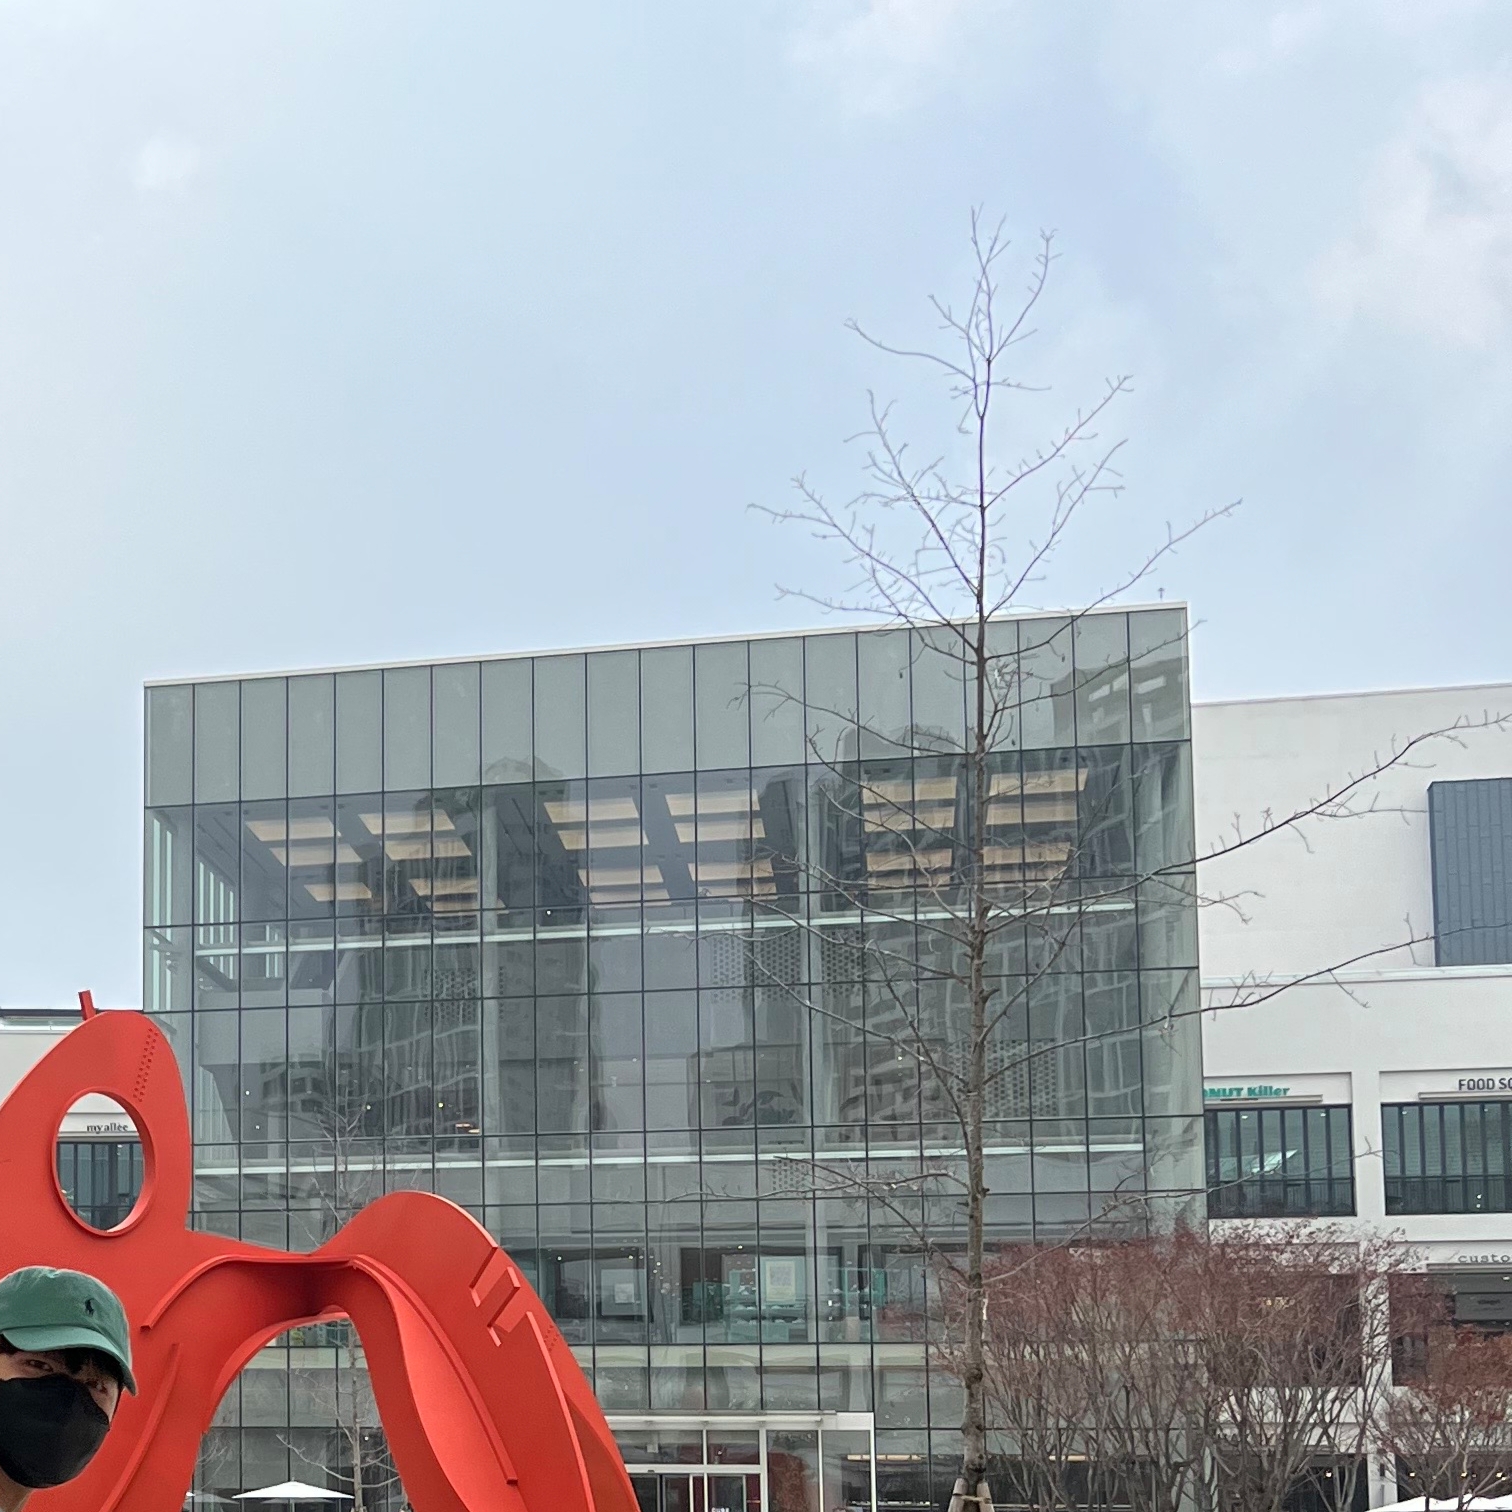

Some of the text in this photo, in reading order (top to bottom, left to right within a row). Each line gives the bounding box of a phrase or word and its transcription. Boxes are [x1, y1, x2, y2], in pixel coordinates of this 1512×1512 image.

[1458, 1078, 1495, 1091] FOOD
[1247, 1085, 1290, 1097] Killer
[86, 1124, 102, 1134] my
